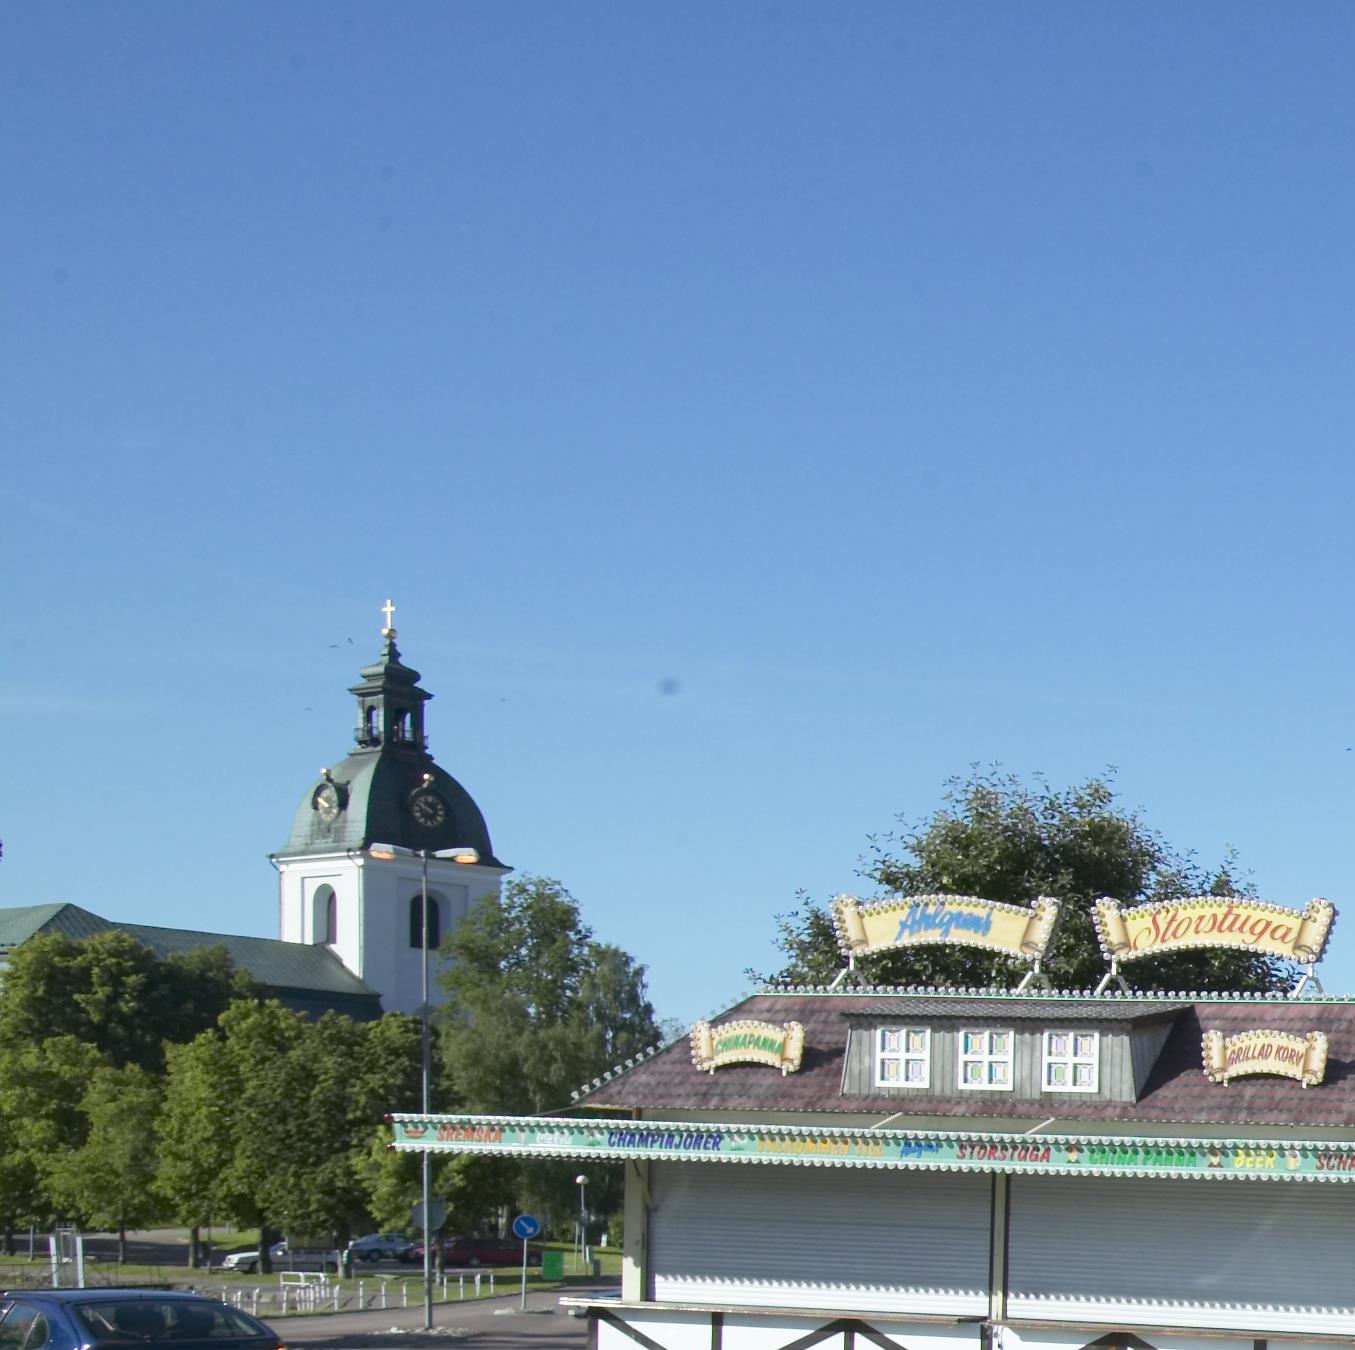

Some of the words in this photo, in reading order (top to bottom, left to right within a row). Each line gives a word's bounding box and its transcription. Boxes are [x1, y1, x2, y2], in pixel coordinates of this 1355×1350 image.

[1132, 905, 1297, 949] Storstuga
[1228, 1043, 1273, 1065] GRILLAD
[1274, 1044, 1305, 1067] KORV
[608, 1130, 722, 1151] CHAMPINJONER
[956, 1142, 1051, 1163] STORSTUGA
